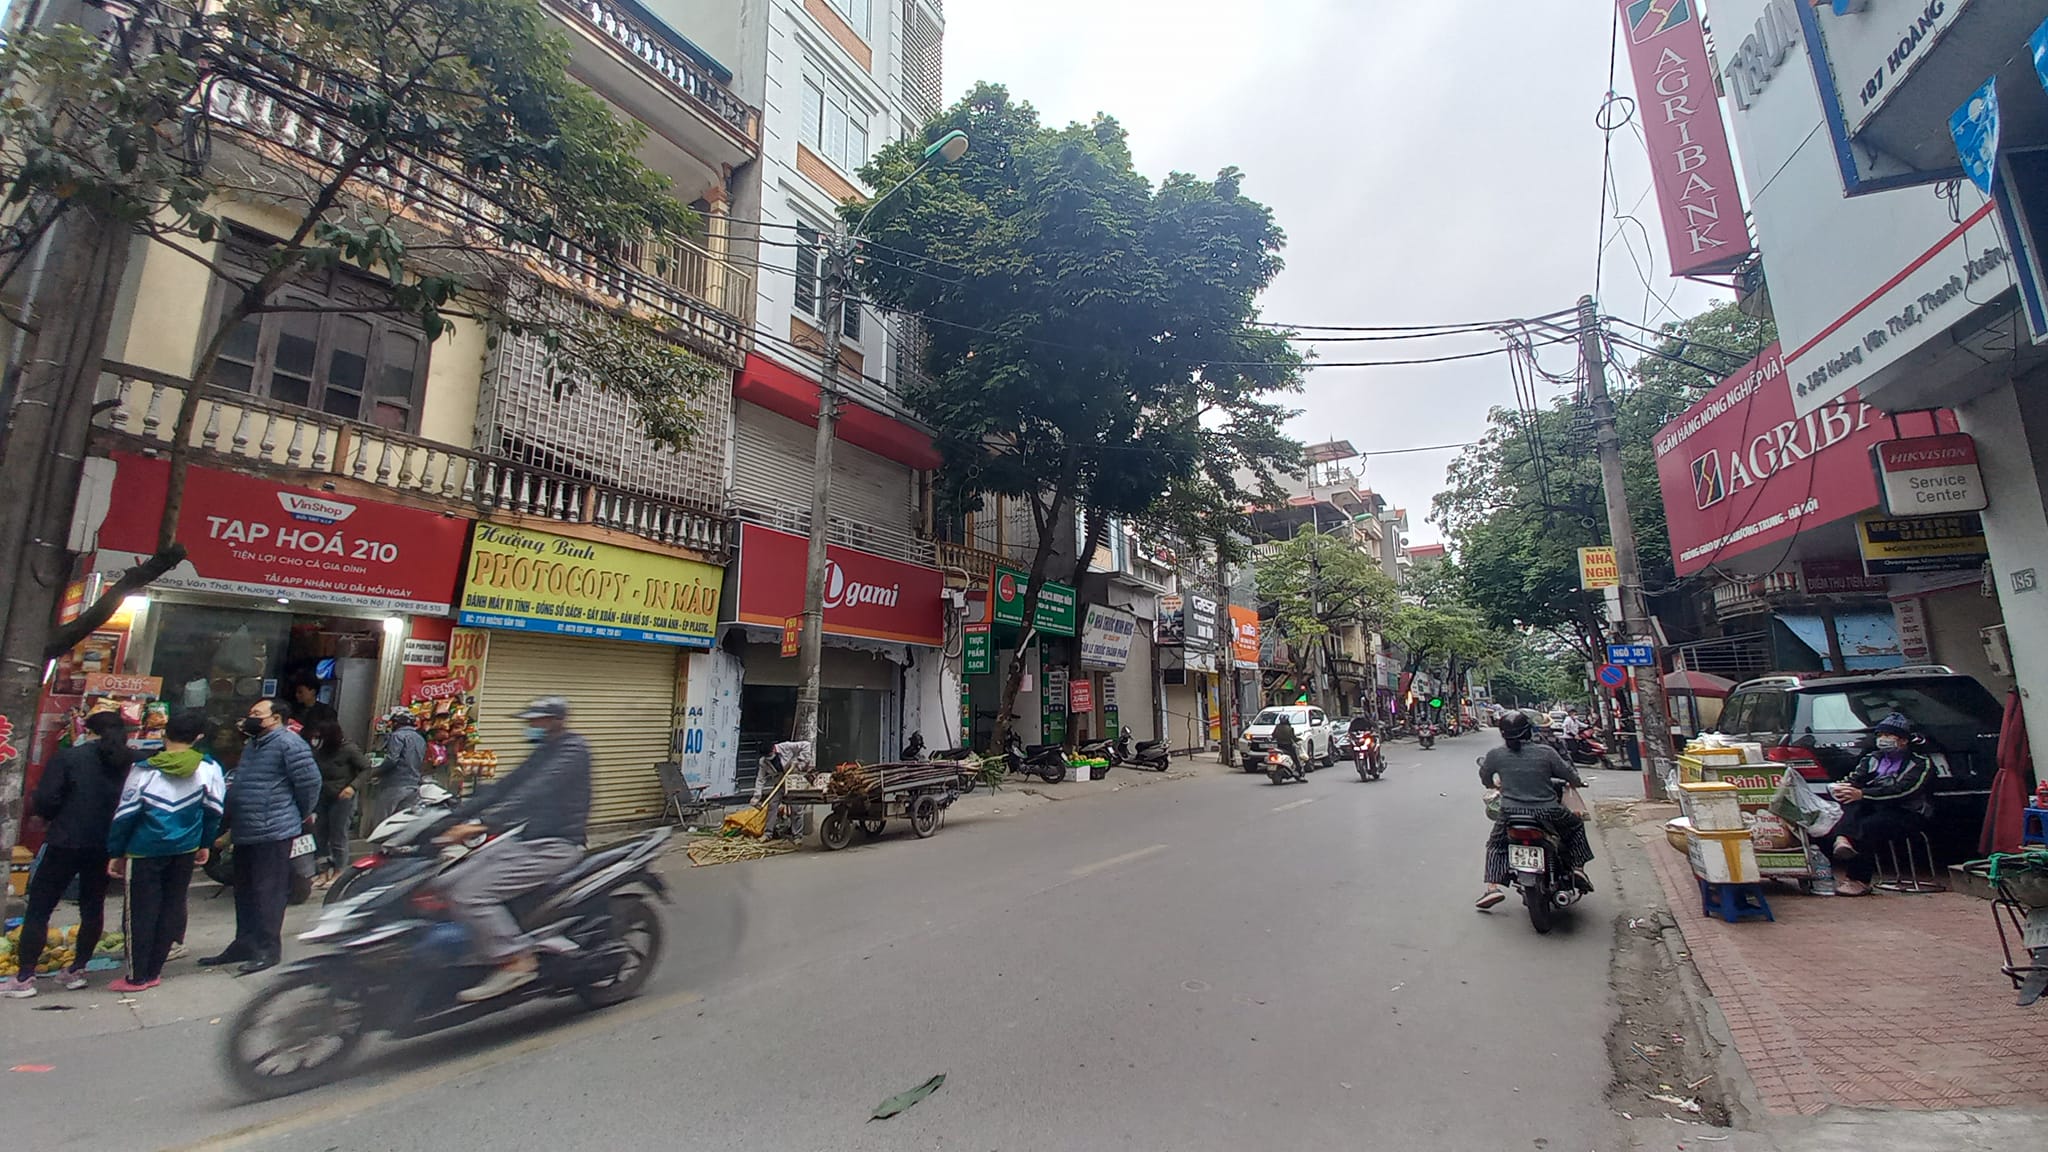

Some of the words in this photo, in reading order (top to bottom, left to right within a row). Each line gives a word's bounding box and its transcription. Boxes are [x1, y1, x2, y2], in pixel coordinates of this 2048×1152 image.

[1860, 66, 1883, 107] 187
[1653, 47, 1729, 254] AGRIBANK
[1826, 345, 1863, 378] Hoàng
[1916, 273, 1964, 316] Thanh
[1656, 433, 1679, 457] NGÂN
[1677, 415, 1702, 442] HÀNG
[1700, 397, 1728, 426] NÔNG
[1890, 447, 1967, 464] HIKVISION
[1909, 474, 1967, 490] Service
[1916, 488, 1967, 503] Center
[290, 497, 342, 517] VinShop
[1870, 518, 1961, 532] WESTERN
[1900, 527, 1961, 540] UNION
[207, 516, 270, 547] TẠP
[275, 528, 345, 557] HOÁ
[351, 539, 399, 563] 210
[552, 539, 596, 561] Bình
[233, 550, 256, 561] TIỆN
[278, 556, 304, 566] CHO
[322, 561, 341, 571] GIA
[283, 576, 303, 585] APP
[471, 550, 631, 604] PHOTOCOPY
[643, 579, 671, 611] IN
[671, 577, 718, 617] MÀU
[466, 592, 487, 609] ĐÁNH
[487, 594, 505, 610] MÁY
[514, 597, 531, 612] TÍNH
[535, 600, 554, 616] ĐÓNG
[564, 602, 583, 618] SÁCH
[451, 633, 486, 660] PHO
[103, 675, 143, 690] Oishi
[421, 680, 456, 698] Oishi
[452, 665, 479, 692] TO
[688, 707, 704, 717] A4
[684, 728, 704, 754] A0
